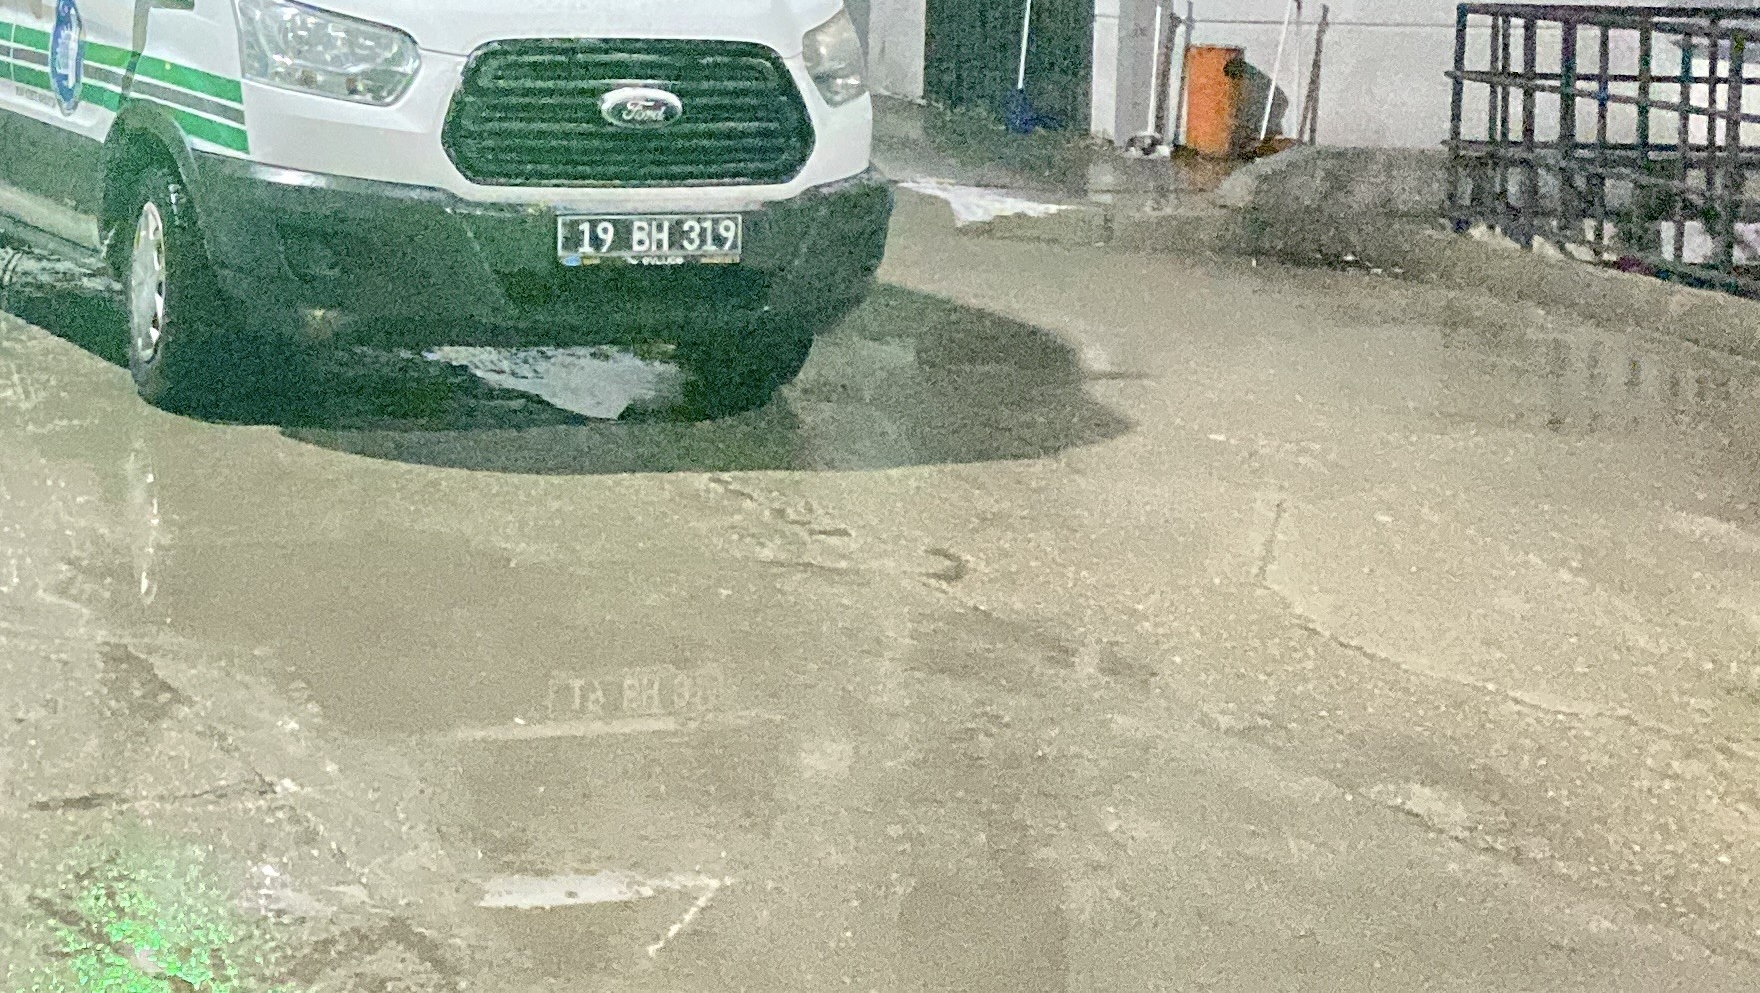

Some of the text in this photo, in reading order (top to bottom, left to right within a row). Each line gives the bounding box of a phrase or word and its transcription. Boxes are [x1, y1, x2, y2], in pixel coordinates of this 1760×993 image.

[622, 101, 667, 121] Ford
[578, 219, 737, 254] 19 BH 319
